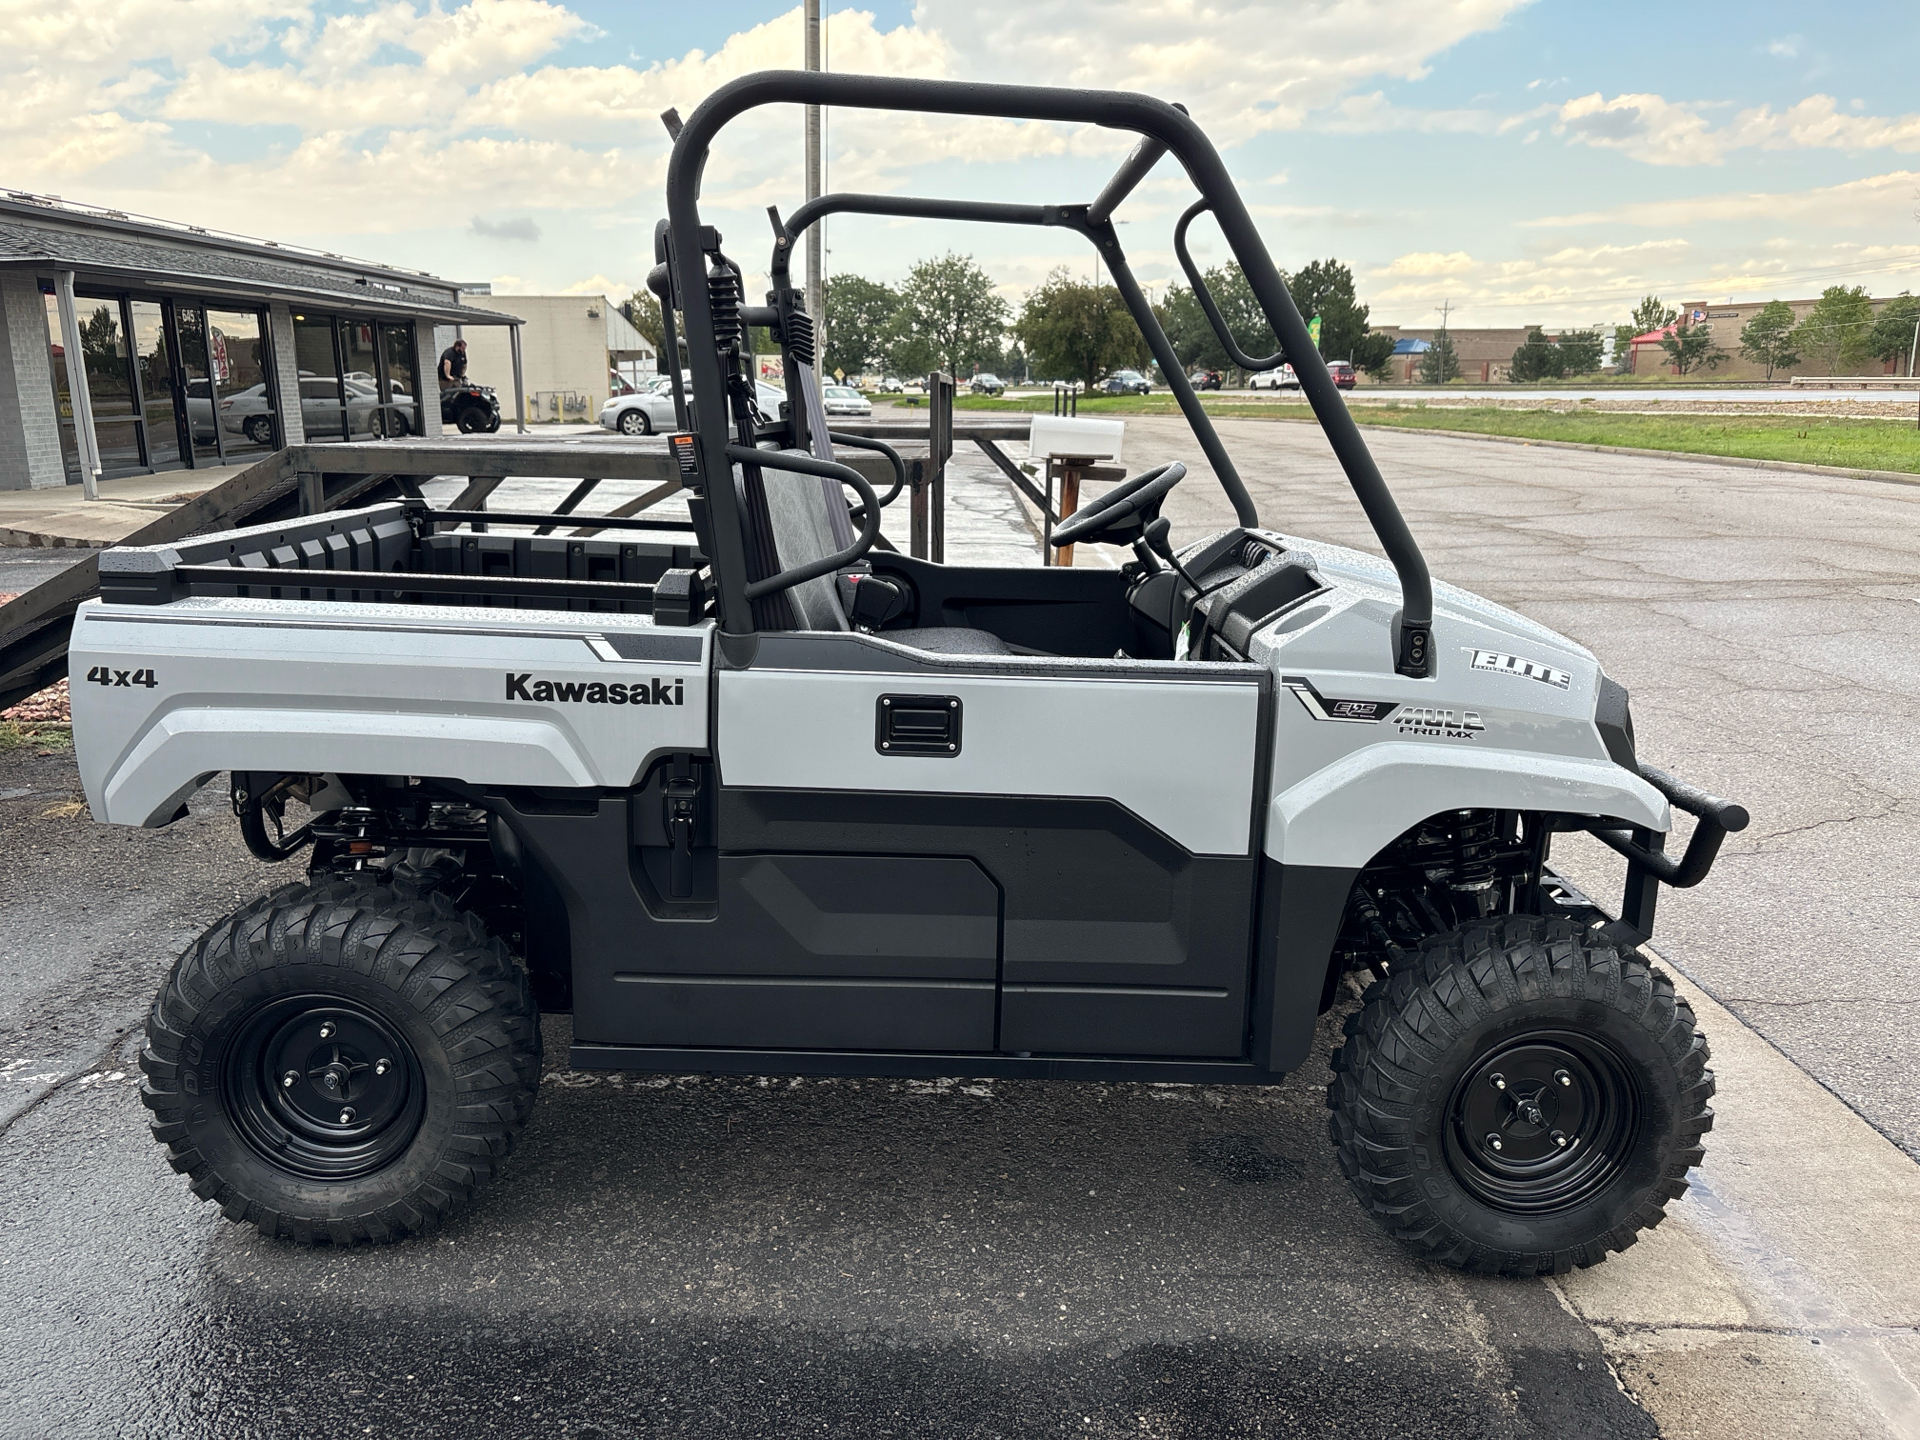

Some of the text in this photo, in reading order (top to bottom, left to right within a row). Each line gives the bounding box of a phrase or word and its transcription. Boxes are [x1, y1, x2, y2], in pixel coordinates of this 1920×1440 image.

[87, 666, 159, 689] 4x4
[1474, 651, 1570, 685] ELITE
[506, 672, 684, 706] Kawasaki
[1333, 701, 1378, 715] EPS
[1391, 707, 1487, 731] MULE
[182, 988, 243, 1096] DURO
[1412, 1073, 1449, 1200] DURO
